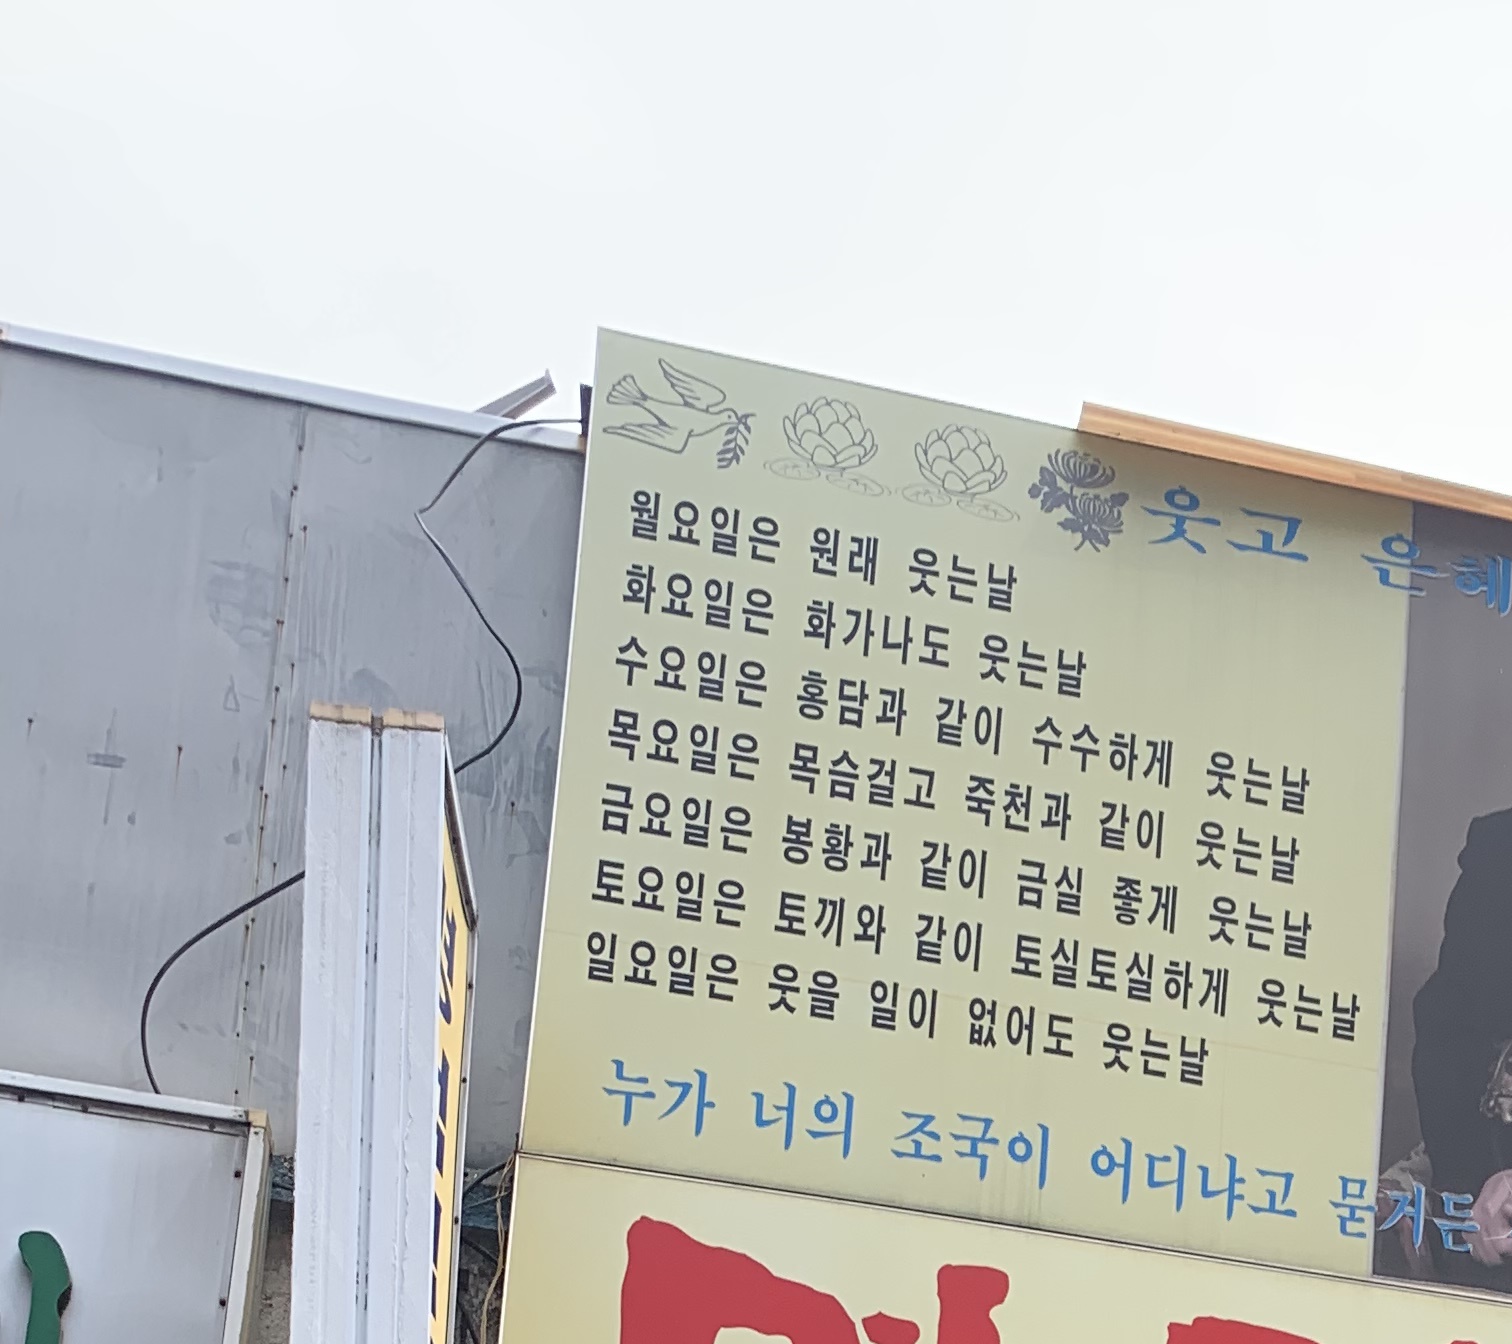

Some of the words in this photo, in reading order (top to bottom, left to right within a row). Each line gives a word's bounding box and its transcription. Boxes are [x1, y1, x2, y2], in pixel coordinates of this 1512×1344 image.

[630, 490, 781, 564] 월요일은
[809, 527, 879, 586] 원래
[908, 548, 1018, 613] 웃는날
[1141, 485, 1309, 563] 웃고
[622, 563, 774, 636] 화요일은
[803, 599, 950, 668] 화가나도
[979, 634, 1087, 699] 웃는날
[607, 708, 760, 781] 목요일은
[964, 774, 1072, 841] 죽천과
[1099, 801, 1165, 859] 같이
[1196, 821, 1300, 885] 웃는날
[615, 635, 768, 709] 수요일은
[796, 670, 908, 737] 홍담과
[935, 697, 1003, 756] 같이
[1032, 716, 1174, 789] 수수하게
[1206, 751, 1310, 815] 웃는날
[591, 859, 746, 928] 토요일은
[774, 891, 887, 955] 토끼와
[915, 913, 983, 973] 같이
[1011, 934, 1230, 1018] 토실토실하게
[1257, 978, 1361, 1042] 웃는날
[601, 782, 753, 854] 금요일은
[781, 814, 892, 881] 봉황과
[920, 840, 988, 899] 같이
[1017, 859, 1083, 916] 금실
[1112, 875, 1178, 935] 좋게
[1208, 896, 1312, 960] 웃는날
[587, 931, 739, 1002] 일요일은
[768, 963, 840, 1021] 웃을
[870, 980, 938, 1039] 일이
[968, 997, 1074, 1058] 없어도
[1102, 1022, 1209, 1087] 웃는날
[602, 1058, 716, 1138] 누가
[751, 1081, 855, 1159] 너의
[890, 1109, 1051, 1190] 조국이
[1090, 1137, 1297, 1220] 어디냐고
